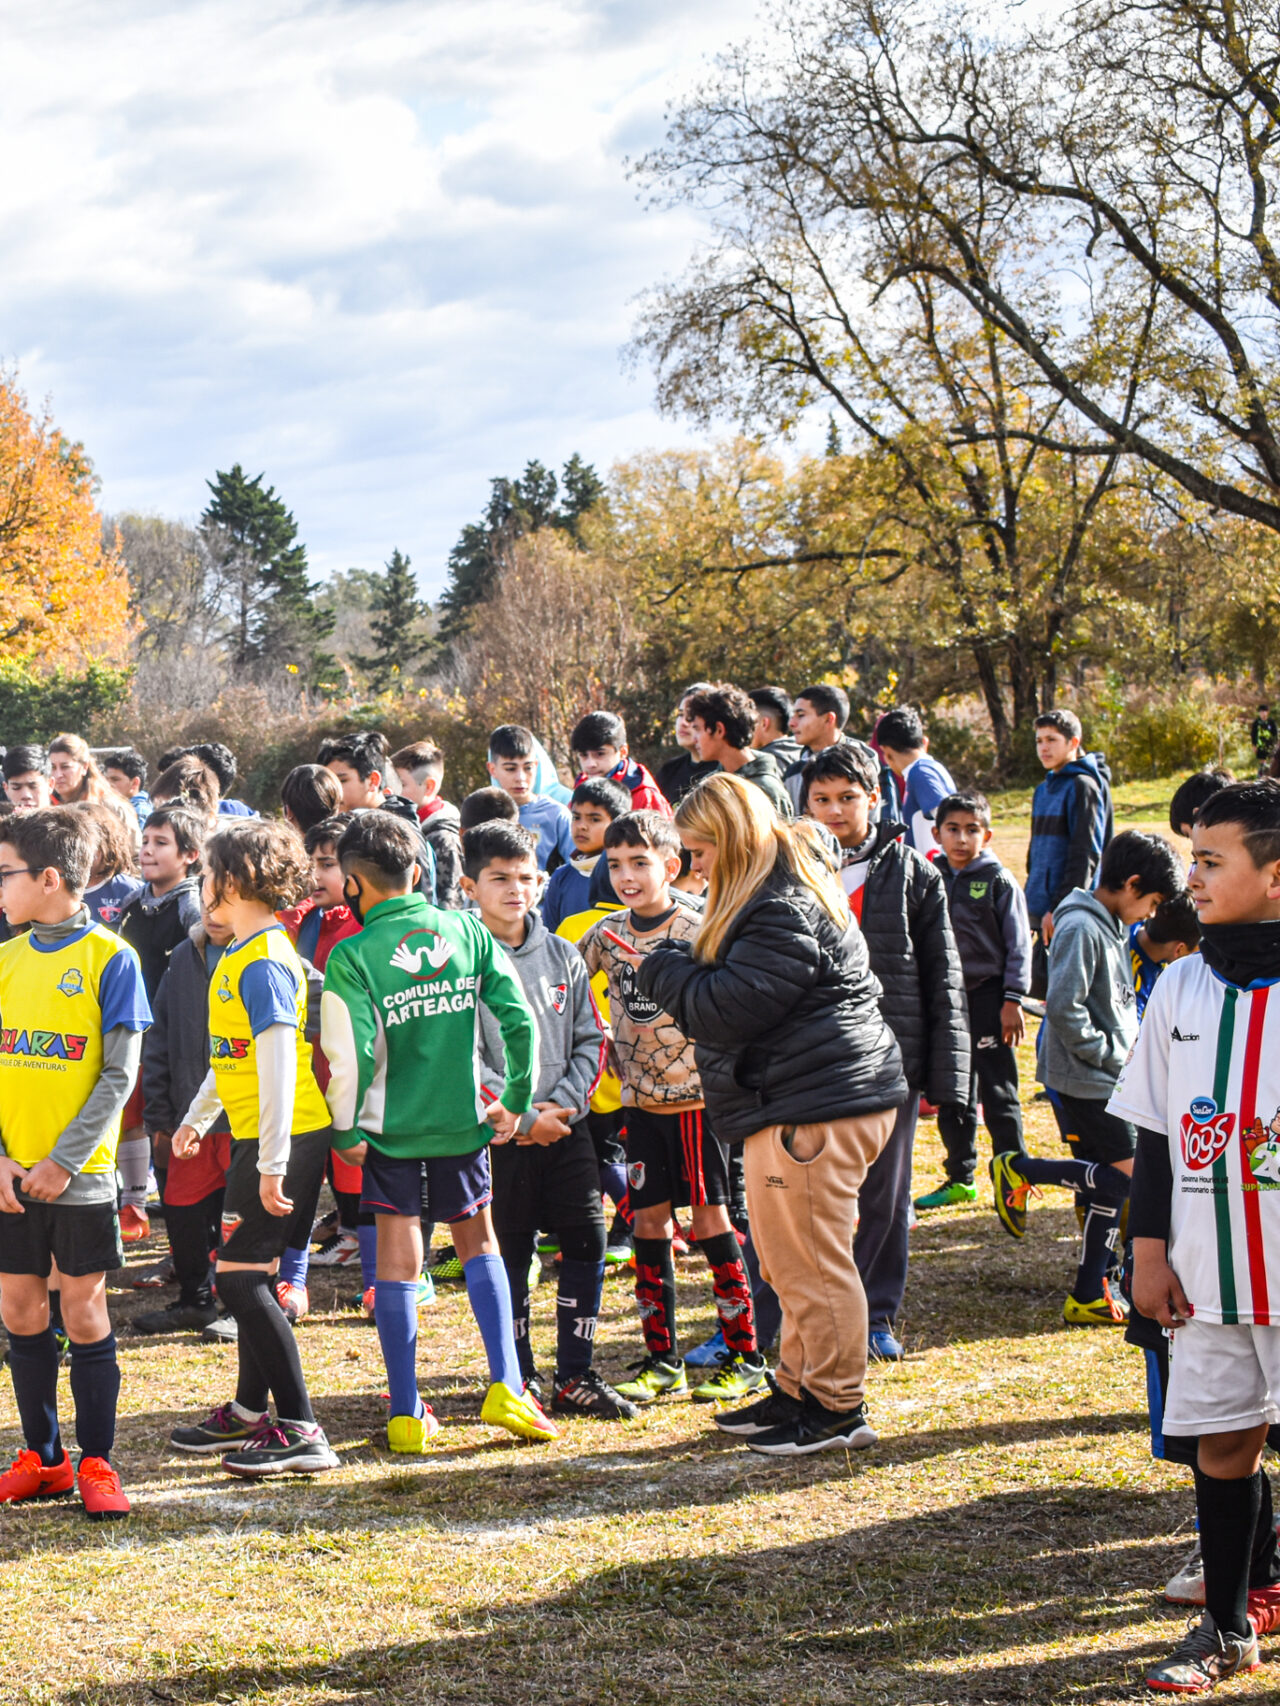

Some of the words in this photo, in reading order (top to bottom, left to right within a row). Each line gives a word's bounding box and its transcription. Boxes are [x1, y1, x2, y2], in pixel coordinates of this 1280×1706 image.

[382, 980, 453, 1009] COMUNA
[455, 976, 475, 991] DE
[628, 1002, 657, 1012] BRAND
[385, 992, 475, 1028] ARTEAGA
[22, 1060, 67, 1072] AVENTURAS
[1180, 1116, 1229, 1165] Yogs
